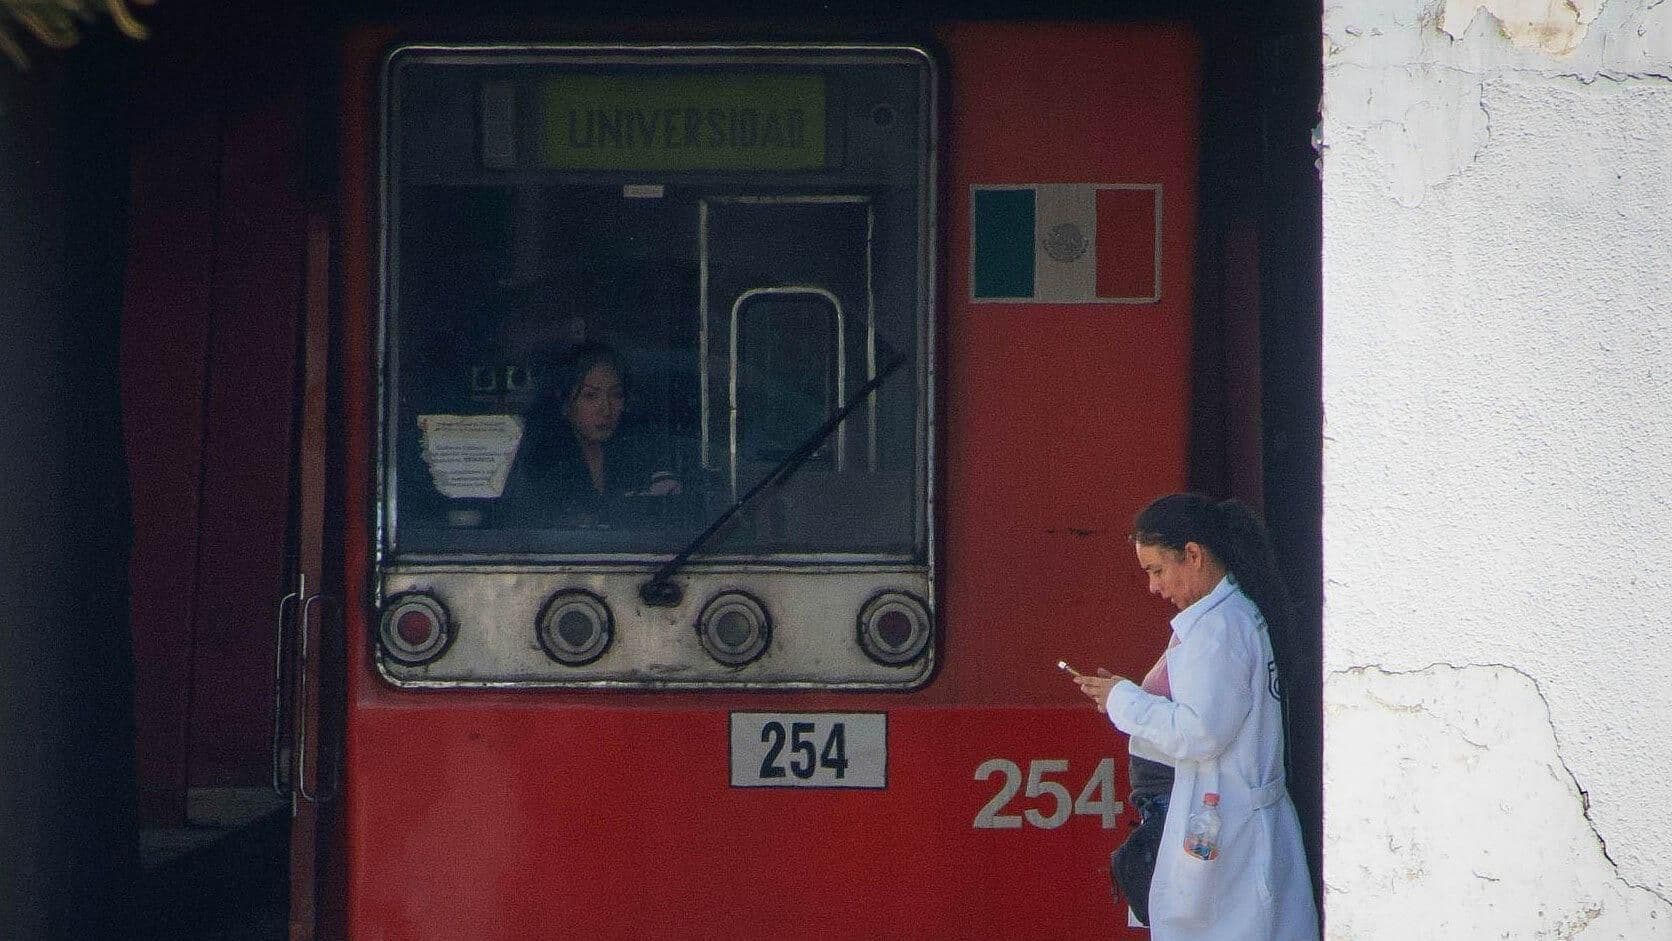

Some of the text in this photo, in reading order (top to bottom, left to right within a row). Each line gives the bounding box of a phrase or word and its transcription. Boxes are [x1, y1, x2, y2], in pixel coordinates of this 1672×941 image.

[569, 108, 804, 149] UNIVERSIDAD
[760, 722, 848, 778] 254
[973, 758, 1124, 829] 254
